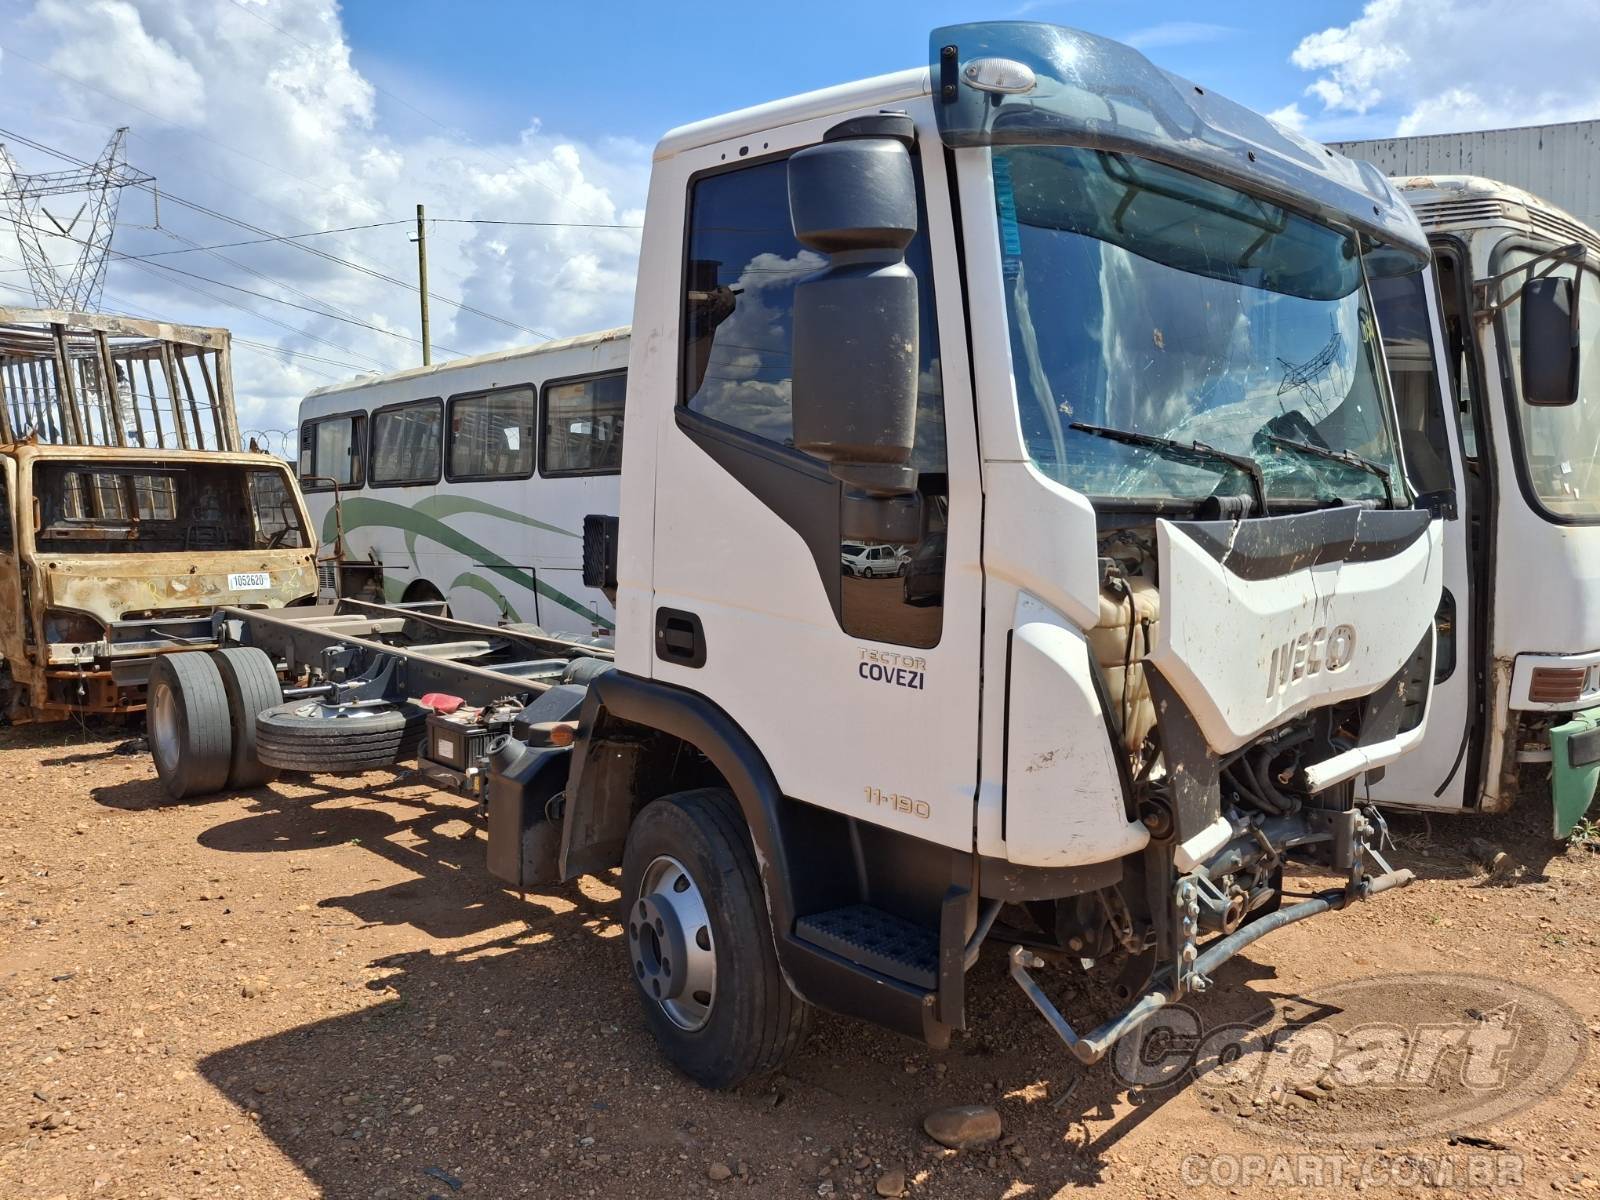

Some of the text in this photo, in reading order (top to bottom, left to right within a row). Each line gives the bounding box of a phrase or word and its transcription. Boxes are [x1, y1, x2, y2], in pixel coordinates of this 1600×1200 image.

[234, 574, 264, 587] 1052620
[857, 647, 927, 671] TECTOR
[1266, 624, 1356, 699] IVECO
[859, 661, 925, 690] COVEZI
[864, 786, 931, 819] 11-190
